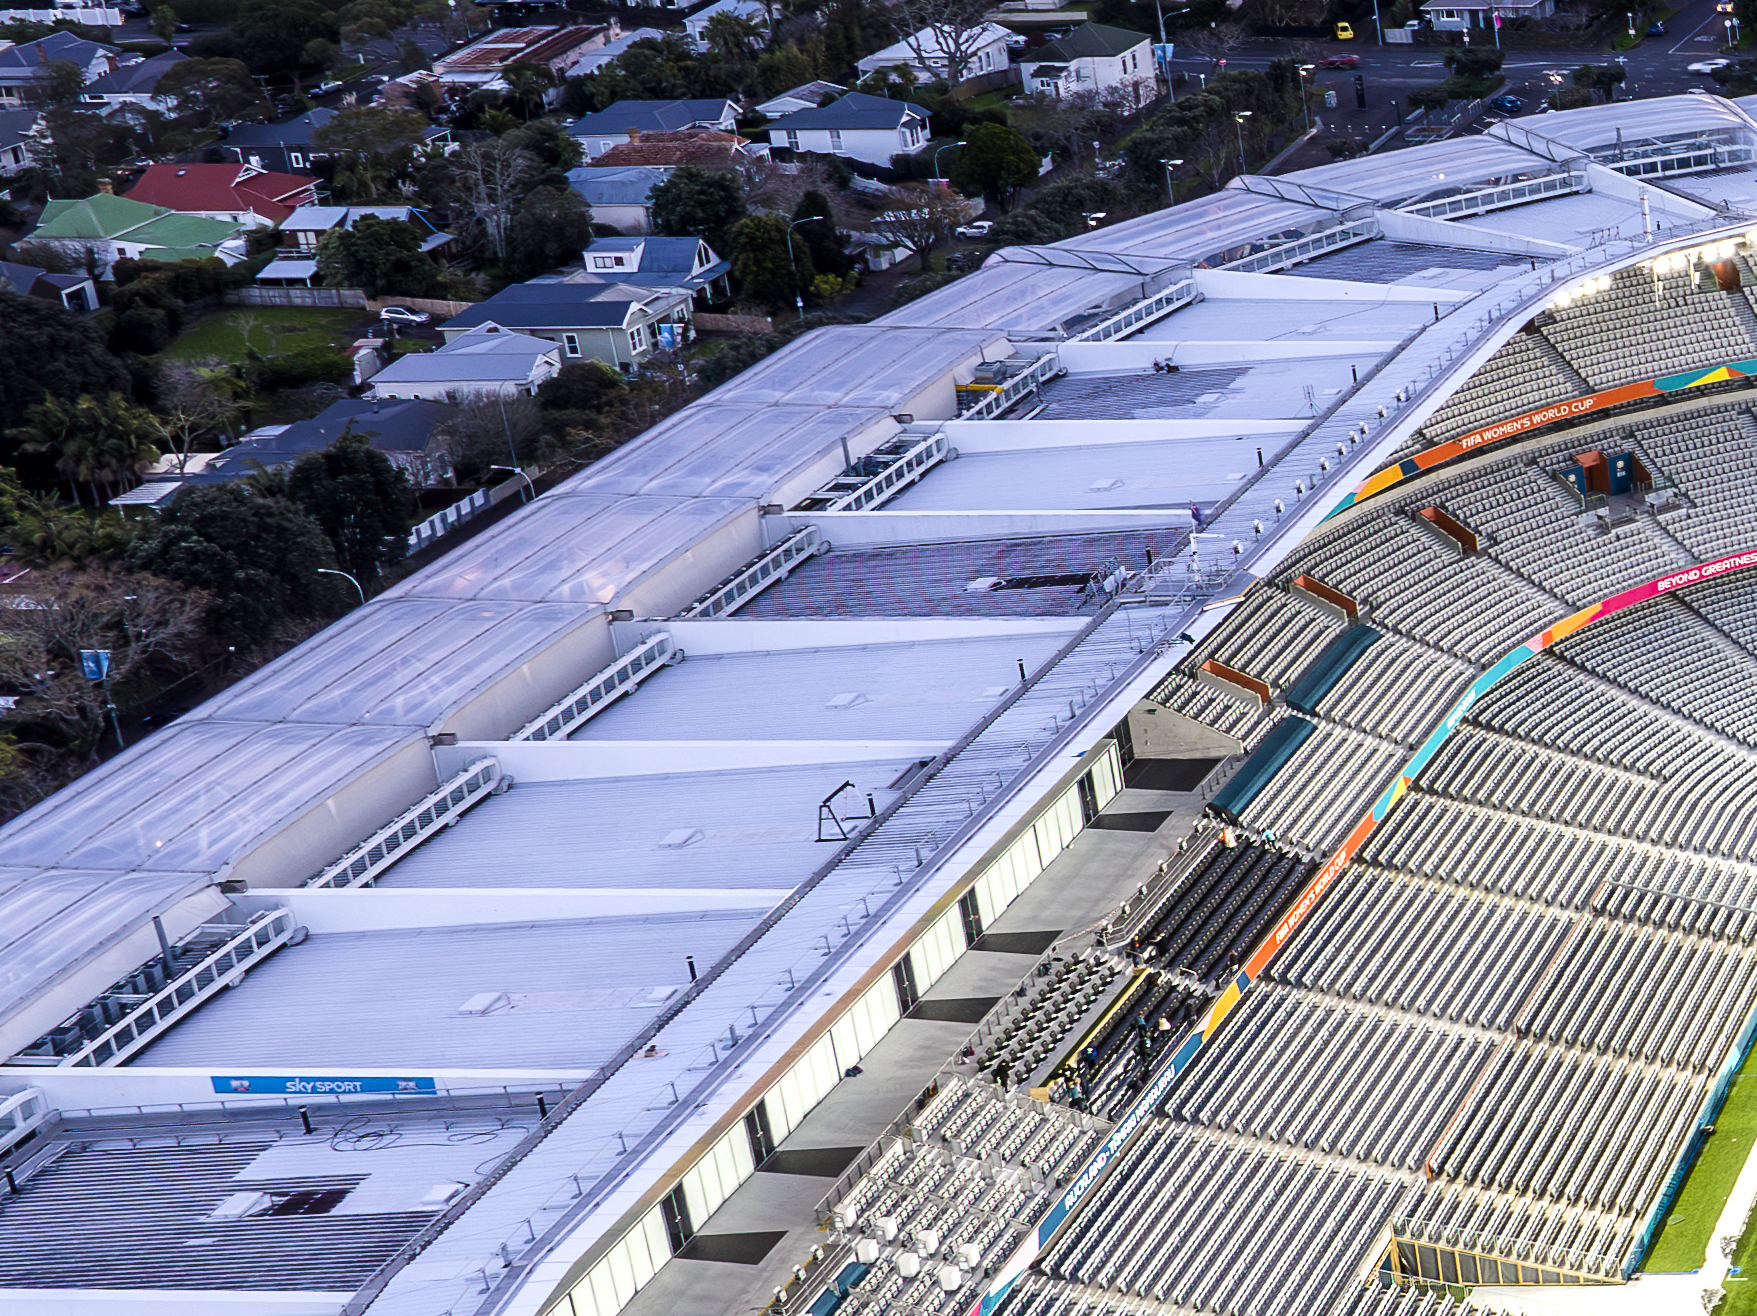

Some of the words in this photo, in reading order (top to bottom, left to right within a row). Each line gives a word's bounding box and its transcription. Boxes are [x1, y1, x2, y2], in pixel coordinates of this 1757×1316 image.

[1461, 431, 1482, 449] FIFA
[1483, 416, 1530, 443] WOMEN'S
[1532, 403, 1570, 430] WORLD
[1657, 567, 1699, 592] BEYOND
[286, 1077, 315, 1094] sky
[316, 1081, 362, 1092] SPORT
[1064, 1152, 1107, 1211] AUCKLAND
